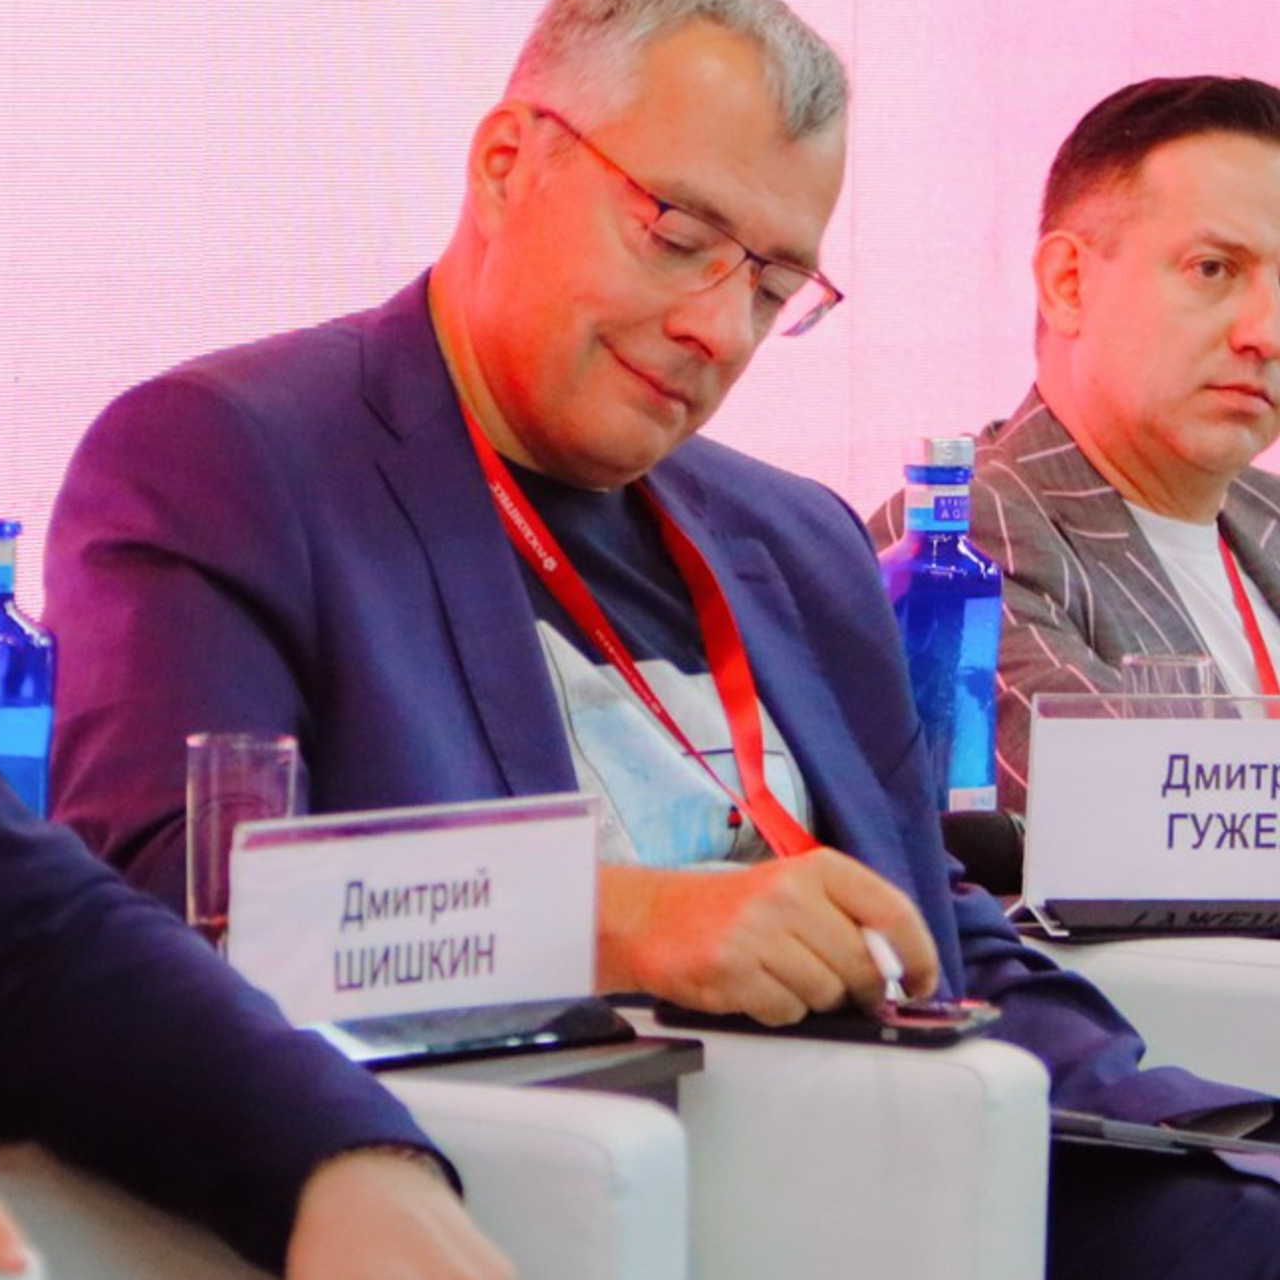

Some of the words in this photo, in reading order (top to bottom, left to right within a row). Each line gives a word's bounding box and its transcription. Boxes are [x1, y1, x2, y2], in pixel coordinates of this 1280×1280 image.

[1167, 812, 1280, 850] ГУЖЕ
[340, 866, 492, 931] Дмитрий
[333, 933, 496, 993] ШИШКИН
